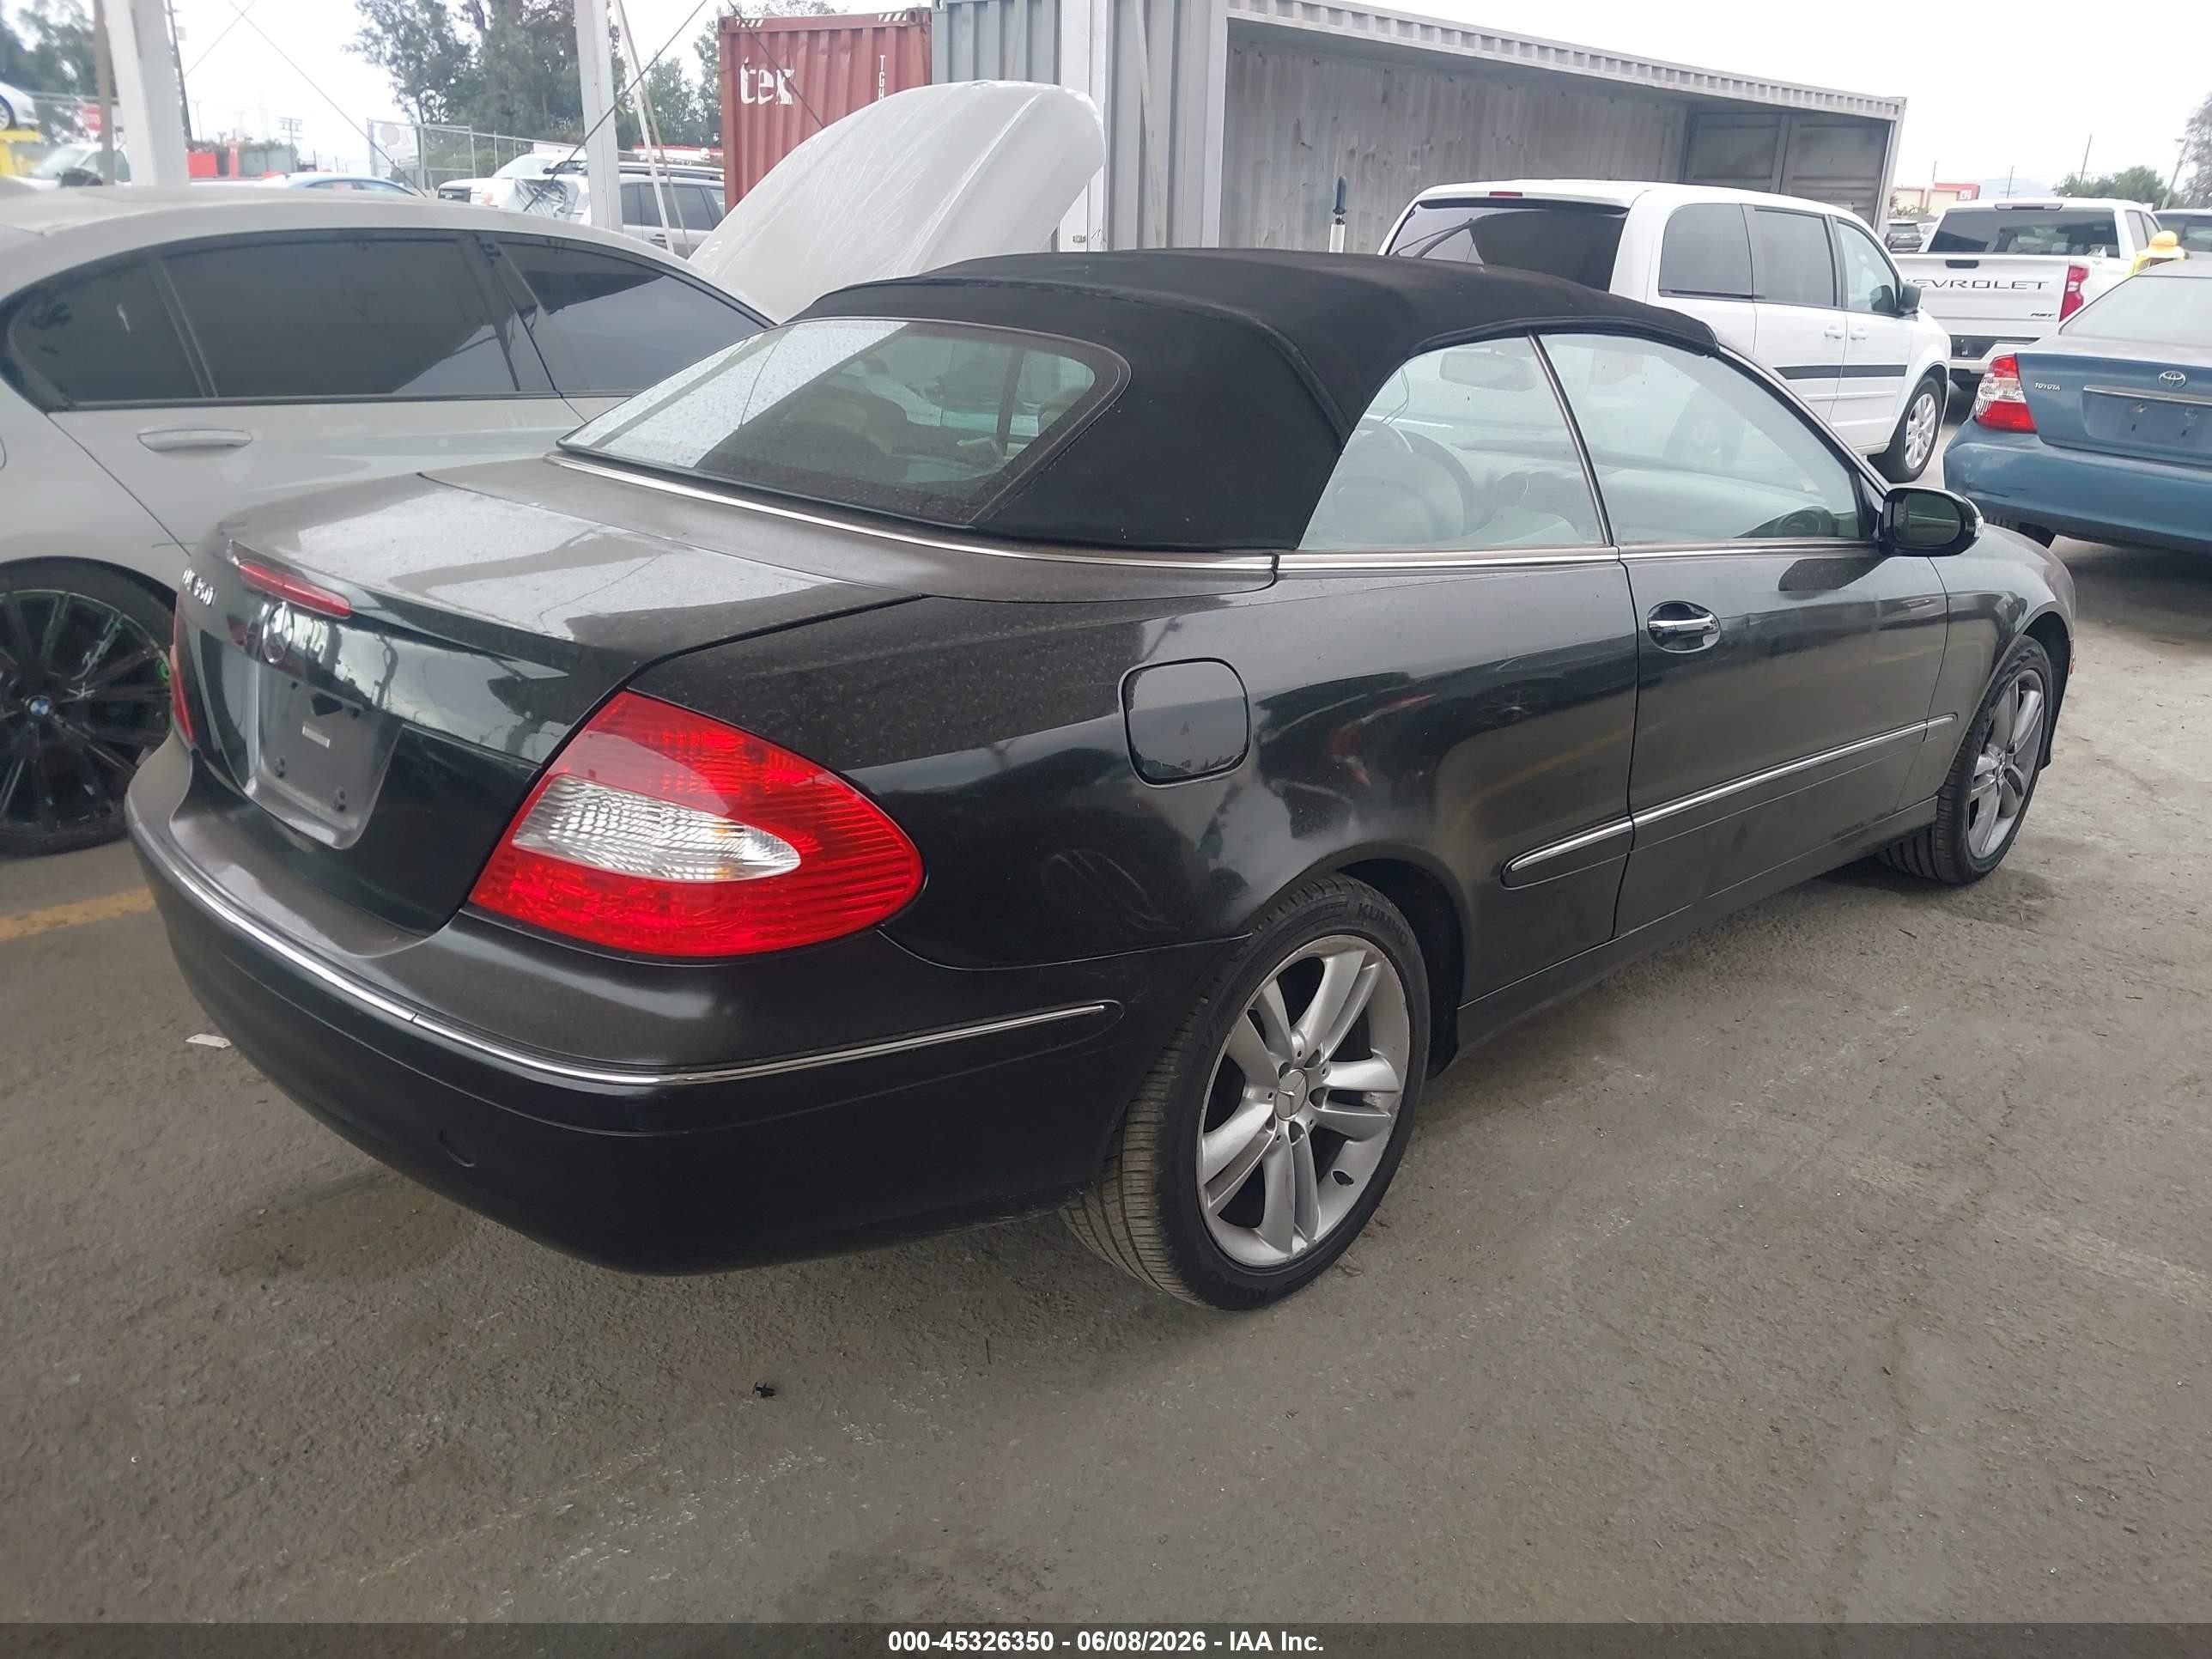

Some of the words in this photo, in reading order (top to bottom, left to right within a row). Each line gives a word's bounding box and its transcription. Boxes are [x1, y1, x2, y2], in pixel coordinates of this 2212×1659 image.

[740, 56, 795, 105] tex
[1905, 278, 2050, 290] EVROLET
[2034, 382, 2061, 392] TOYOTA
[1358, 902, 1408, 946] KUMHO
